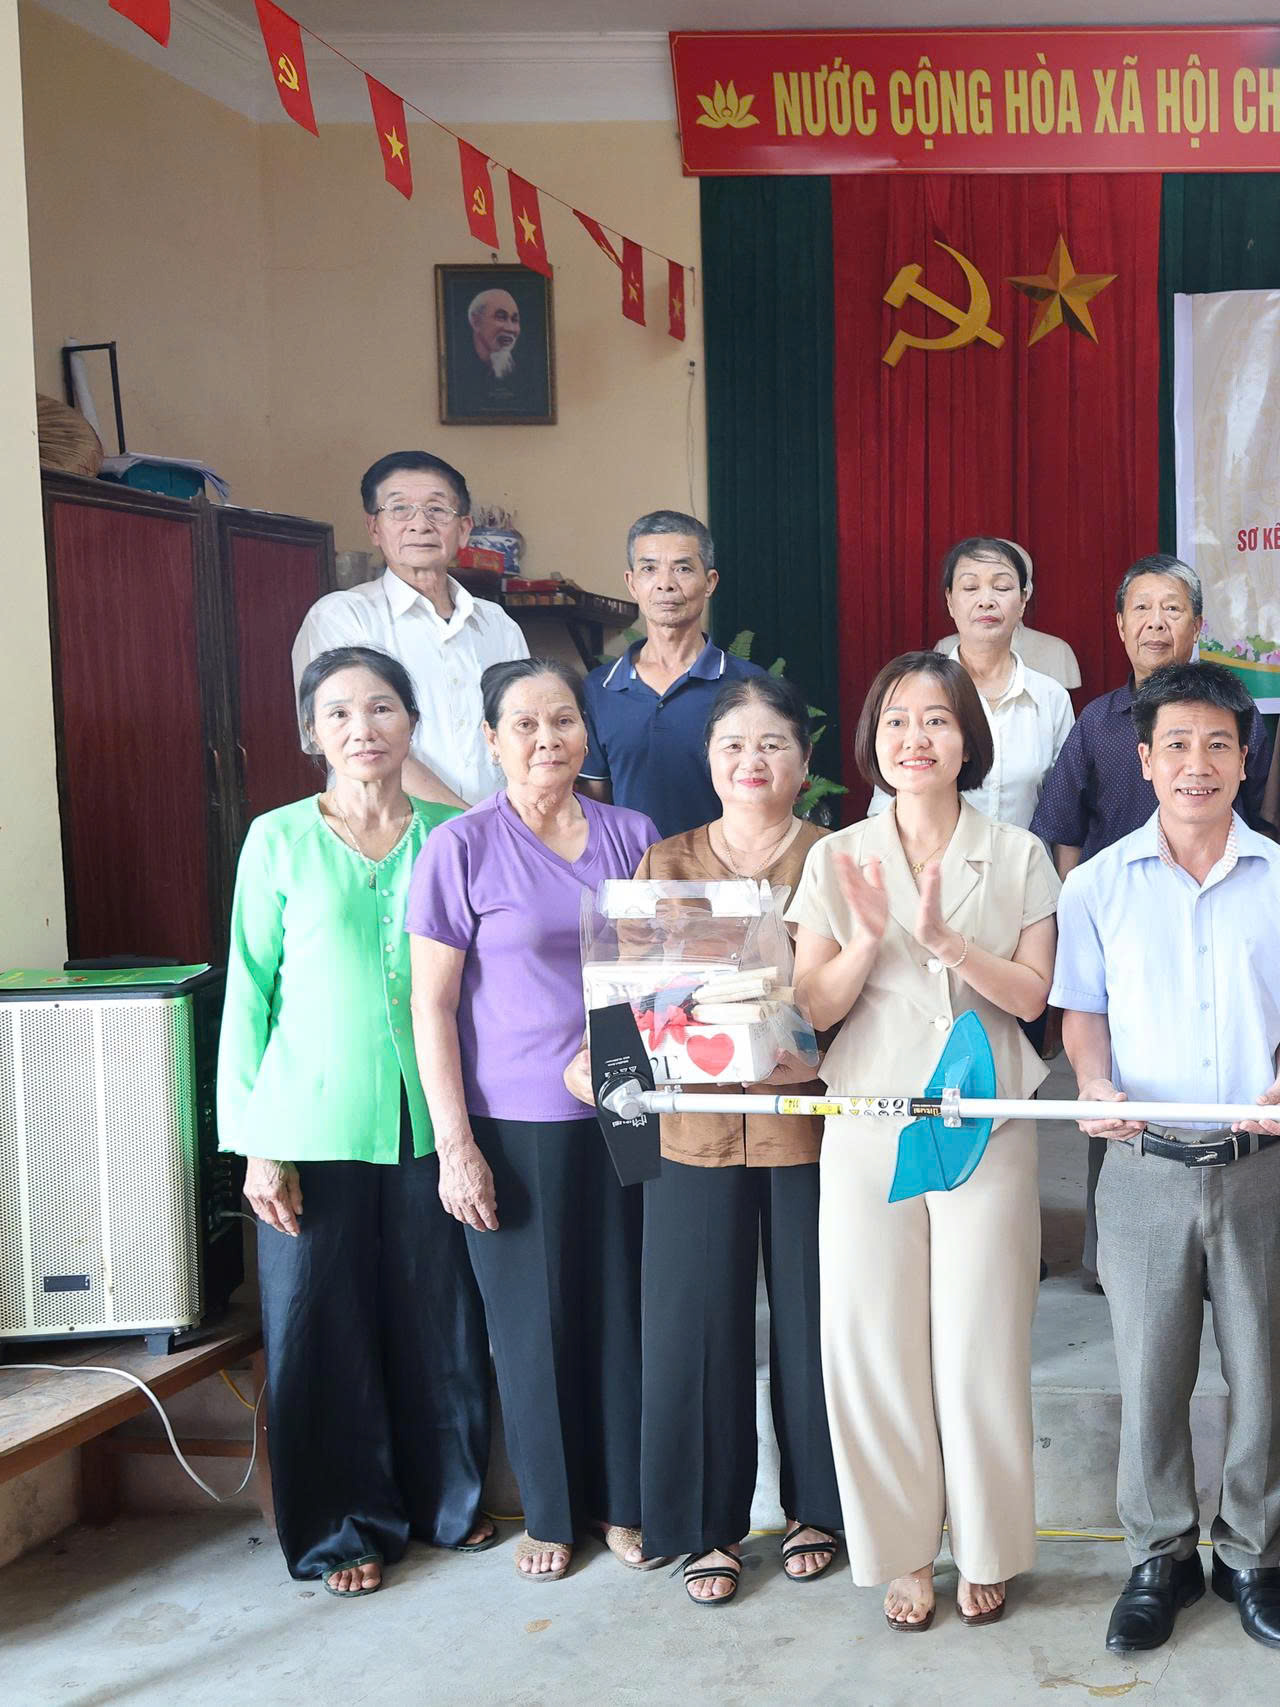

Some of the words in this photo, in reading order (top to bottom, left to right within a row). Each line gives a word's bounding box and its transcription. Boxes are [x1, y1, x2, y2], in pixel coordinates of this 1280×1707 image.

[772, 57, 877, 136] NƯỚC
[889, 56, 992, 149] CỘNG
[1005, 52, 1083, 134] HÒA
[1093, 55, 1145, 134] XÃ
[1158, 54, 1219, 148] HỘI
[1237, 526, 1259, 552] SƠ
